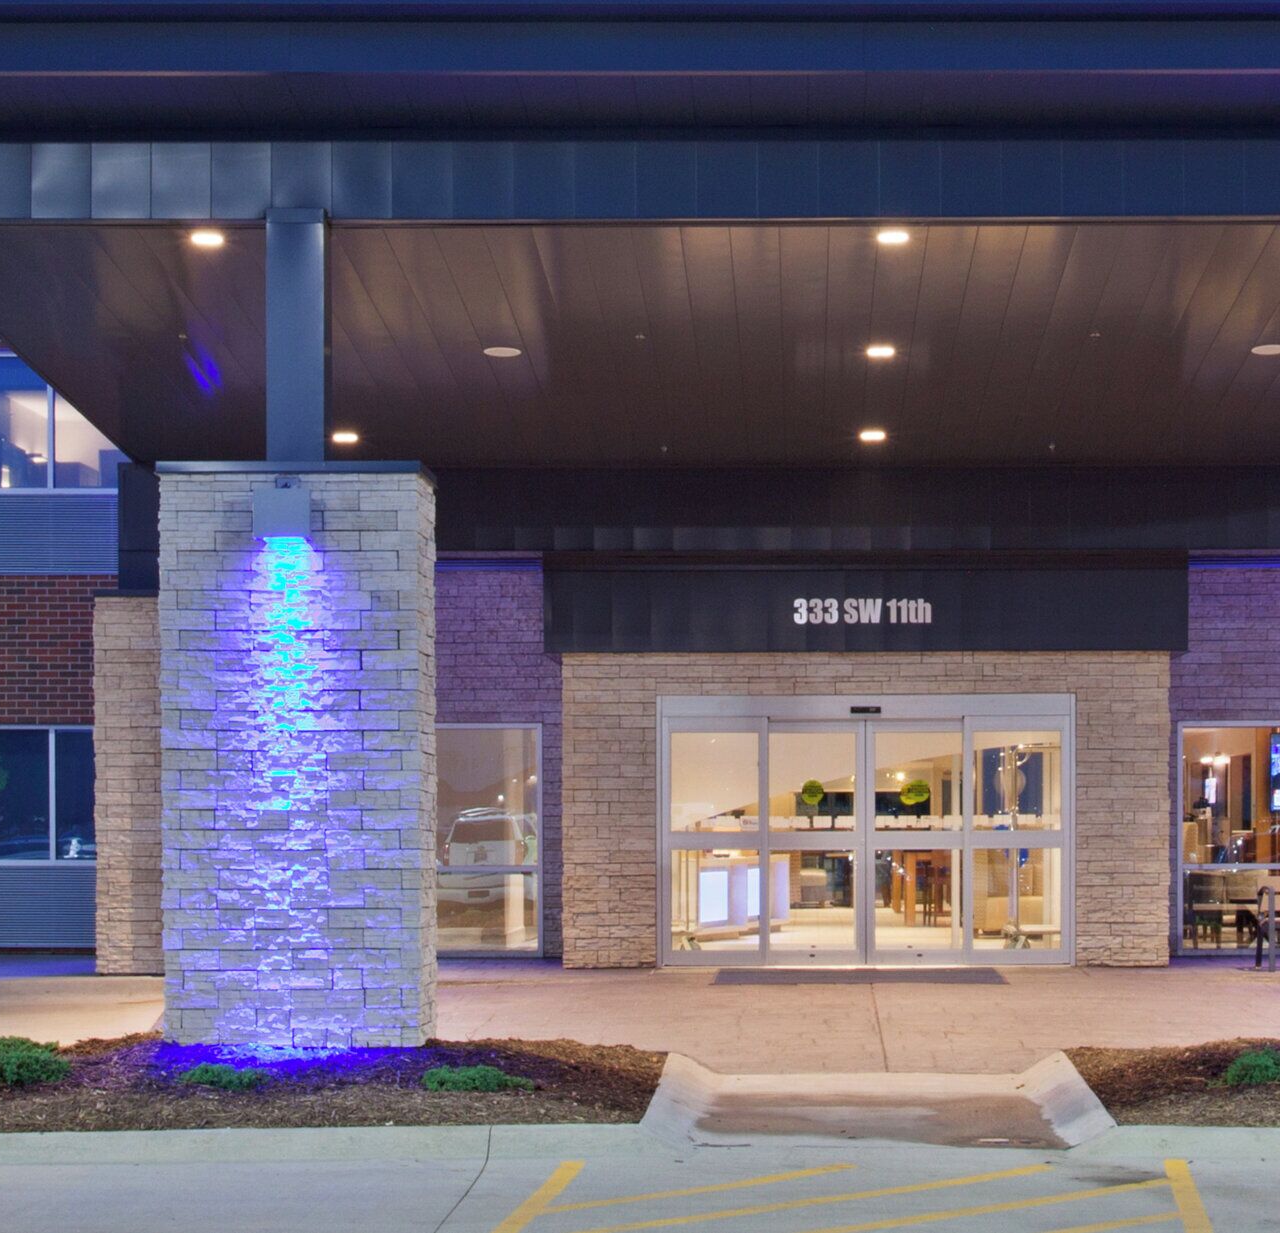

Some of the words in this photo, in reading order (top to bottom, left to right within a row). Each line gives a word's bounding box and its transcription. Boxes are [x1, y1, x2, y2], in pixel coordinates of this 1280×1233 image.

[793, 597, 839, 625] 333
[843, 597, 883, 624] SW
[885, 598, 932, 624] 11th
